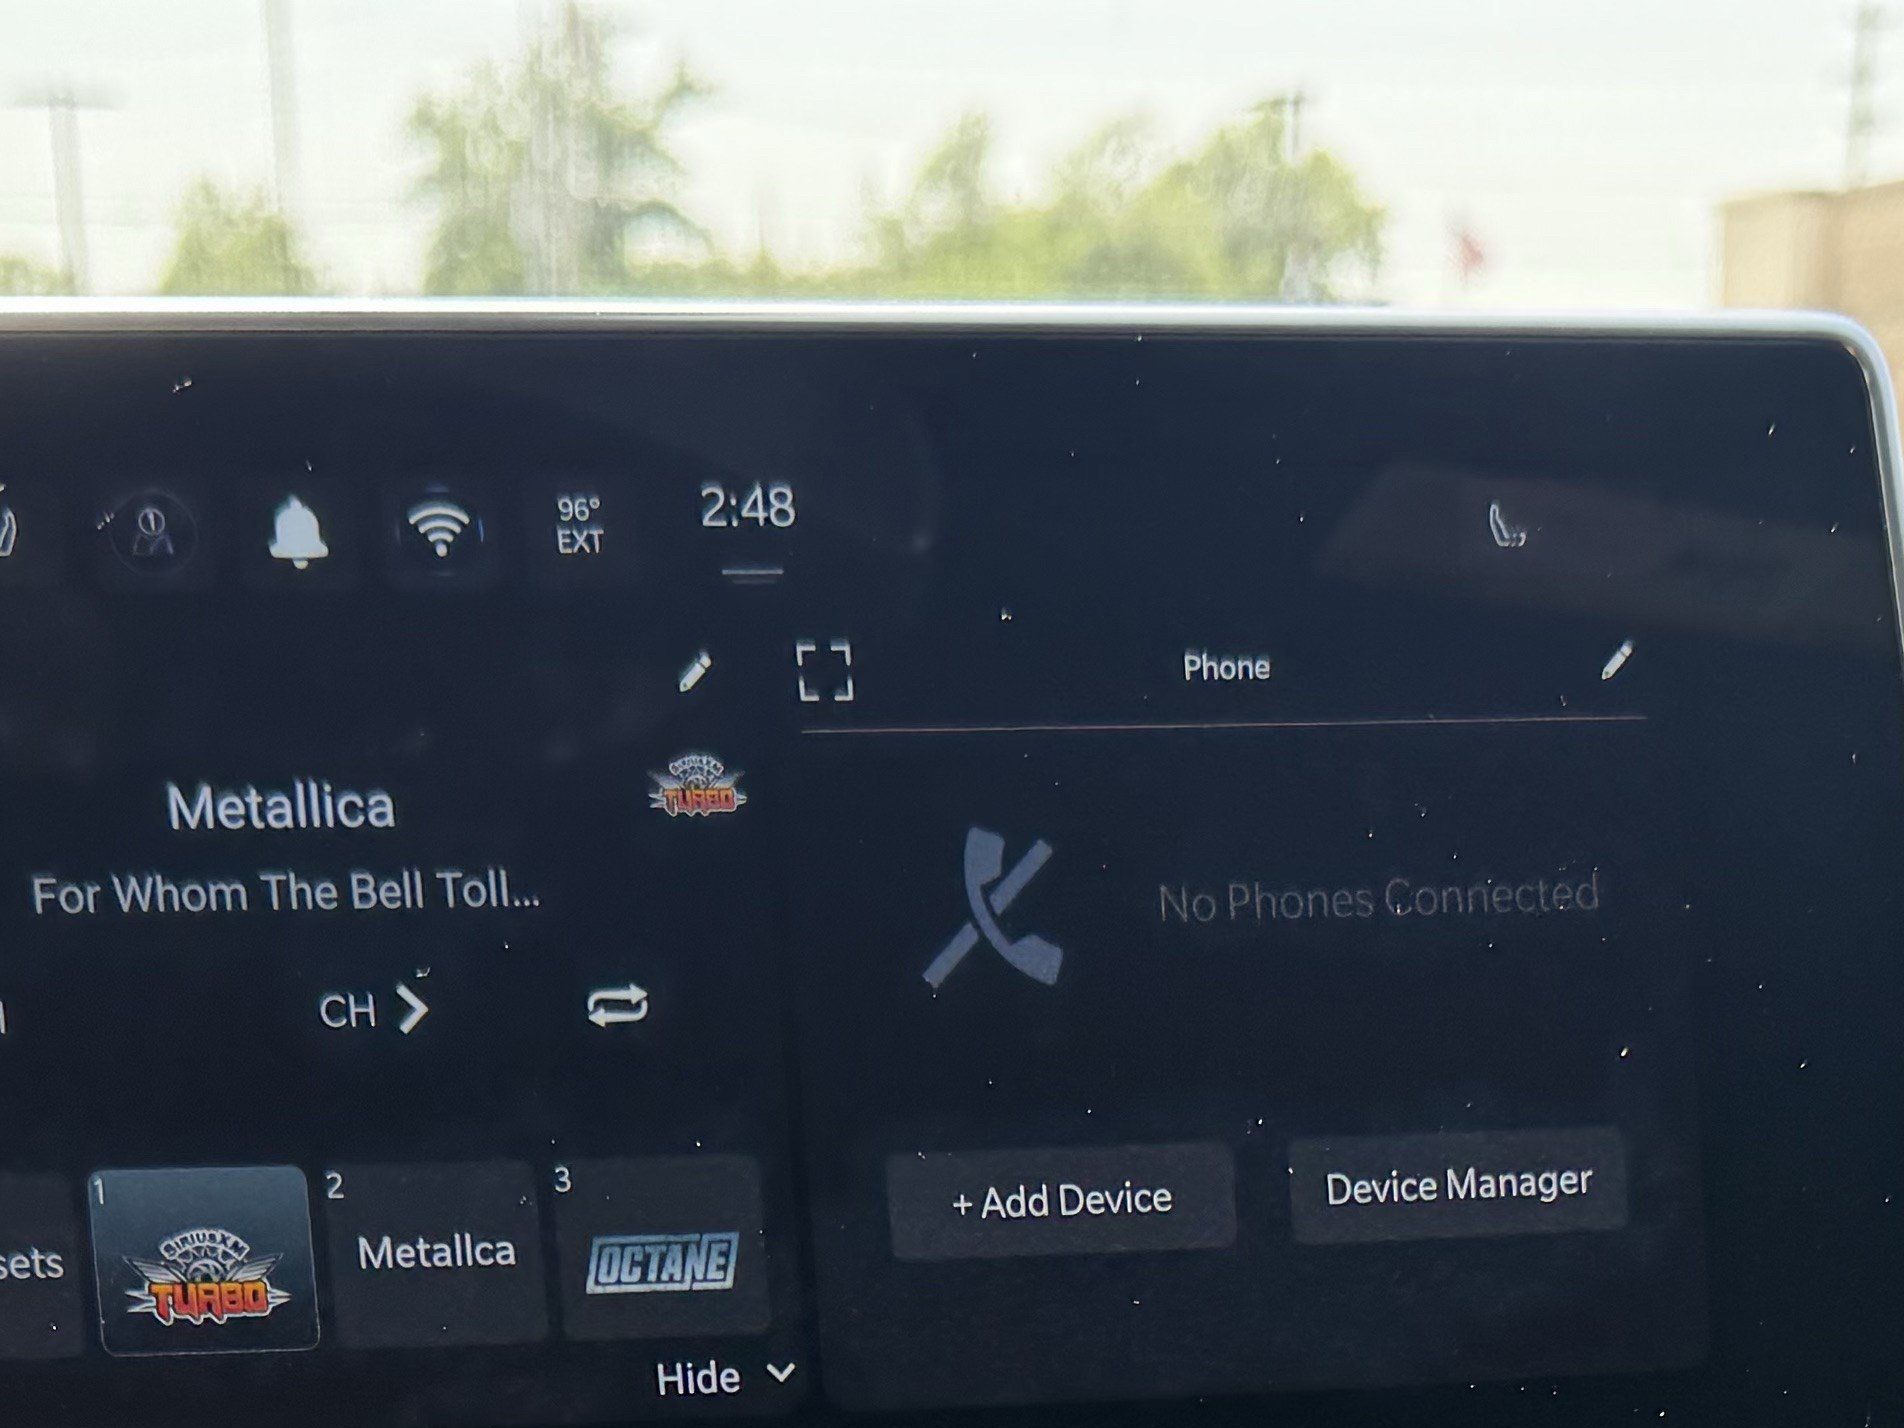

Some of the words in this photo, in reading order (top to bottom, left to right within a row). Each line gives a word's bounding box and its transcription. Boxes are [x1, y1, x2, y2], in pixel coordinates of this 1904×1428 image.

[556, 495, 601, 523] 96°
[701, 482, 796, 528] 2:48
[556, 527, 604, 555] EXT
[1183, 651, 1271, 682] Phone
[167, 779, 396, 831] Metallica
[33, 876, 101, 915] For
[111, 873, 248, 913] Whom
[259, 870, 338, 911] The
[350, 868, 424, 910] Bell
[435, 868, 541, 909] Toll...
[1158, 883, 1217, 923] No
[1227, 880, 1374, 921] Phones
[1384, 871, 1600, 918] Connected
[320, 992, 377, 1029] CH
[93, 1178, 105, 1206] 1
[325, 1171, 345, 1200] 2
[554, 1165, 573, 1194] 3
[980, 1182, 1050, 1220] Add
[1058, 1179, 1173, 1217] Device
[1326, 1168, 1439, 1206] Device
[1446, 1164, 1594, 1214] Manager
[357, 1231, 517, 1271] Metallca
[596, 1240, 729, 1286] OCTANE
[148, 1280, 270, 1325] TURBO
[656, 1358, 741, 1397] Hide
